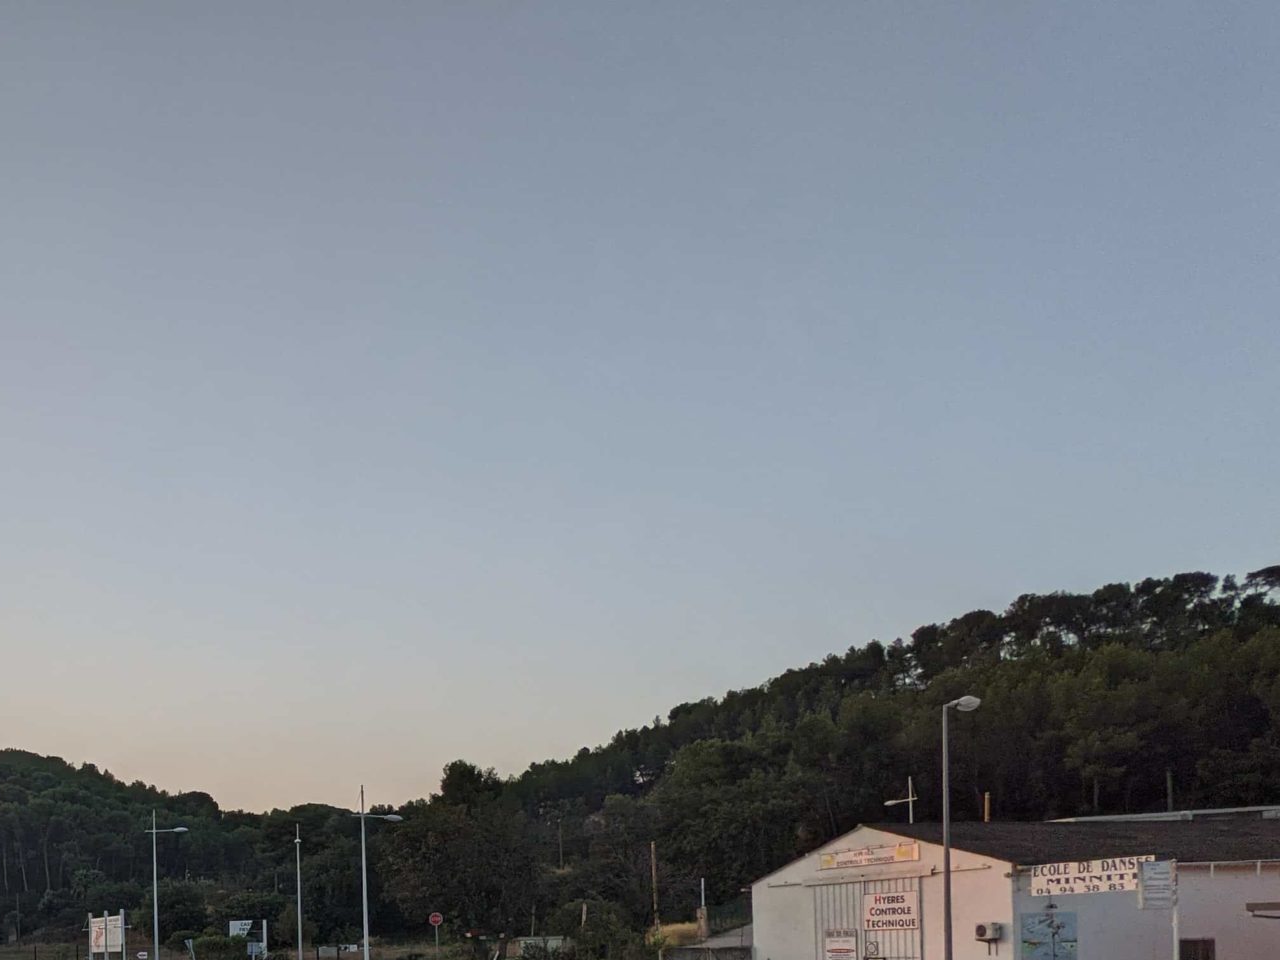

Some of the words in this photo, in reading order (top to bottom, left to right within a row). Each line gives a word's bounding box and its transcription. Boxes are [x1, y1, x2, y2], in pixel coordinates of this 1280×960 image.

[1033, 863, 1070, 878] ECOLE
[1077, 861, 1093, 874] DE
[1036, 887, 1051, 895] 04
[874, 894, 905, 905] HYERES
[869, 906, 912, 916] CONTROLE
[865, 918, 916, 928] TECHNIQUE
